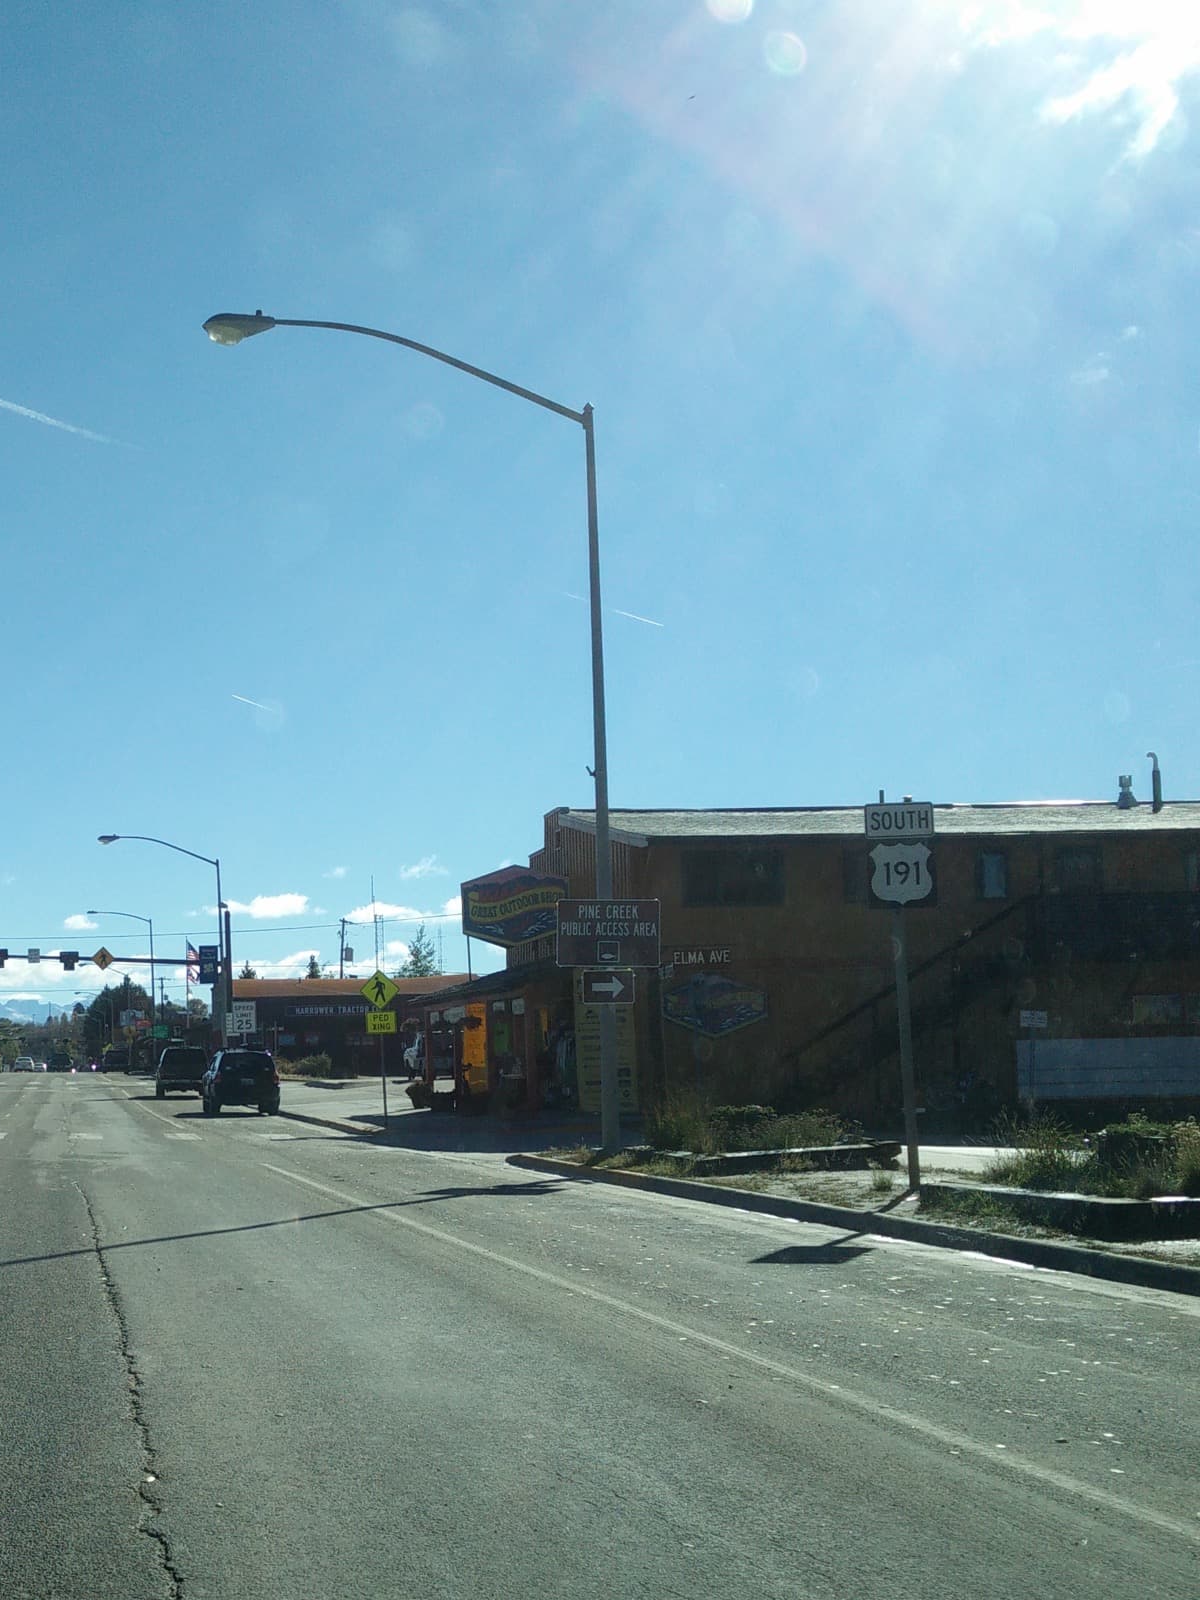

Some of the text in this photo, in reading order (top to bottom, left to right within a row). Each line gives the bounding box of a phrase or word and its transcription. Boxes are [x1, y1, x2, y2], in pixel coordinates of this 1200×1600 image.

[870, 810, 929, 831] SOUTH
[883, 861, 921, 886] 191
[471, 905, 498, 917] GREAT
[499, 893, 539, 915] OUTDOOR
[578, 904, 640, 920] PINE CREEK
[560, 921, 658, 937] PUBLIC ACCESS AREA
[673, 949, 731, 965] ELMA AVE
[237, 1019, 252, 1030] 25
[373, 1014, 390, 1022] PED
[372, 1023, 391, 1031] XING
